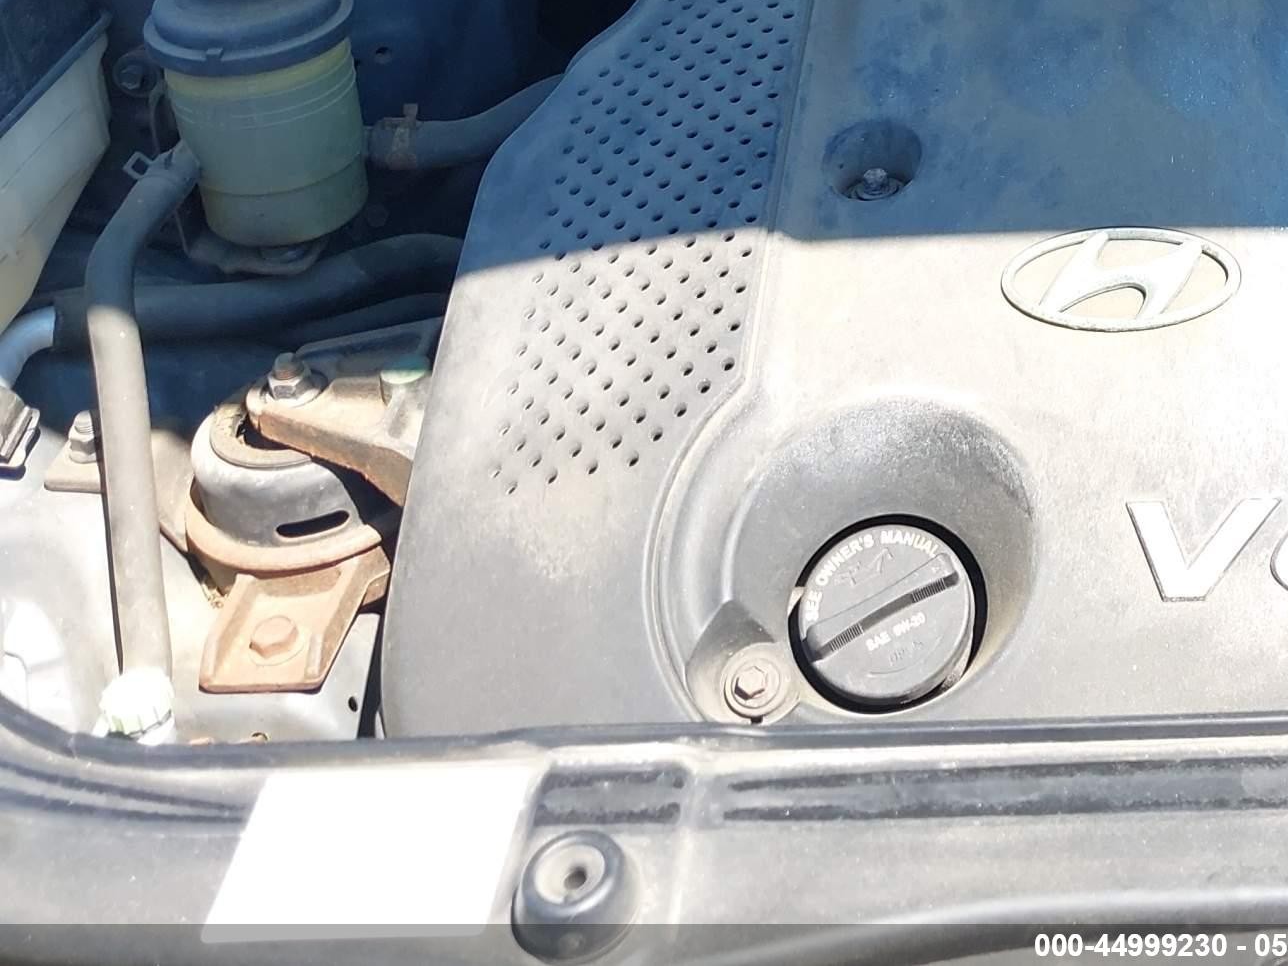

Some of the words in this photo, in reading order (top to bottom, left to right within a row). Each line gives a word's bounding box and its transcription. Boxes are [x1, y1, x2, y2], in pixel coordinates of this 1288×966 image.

[805, 590, 823, 622] SEE
[815, 534, 876, 586] OWNER'S
[880, 530, 940, 557] MANUAL
[865, 631, 892, 652] SAE
